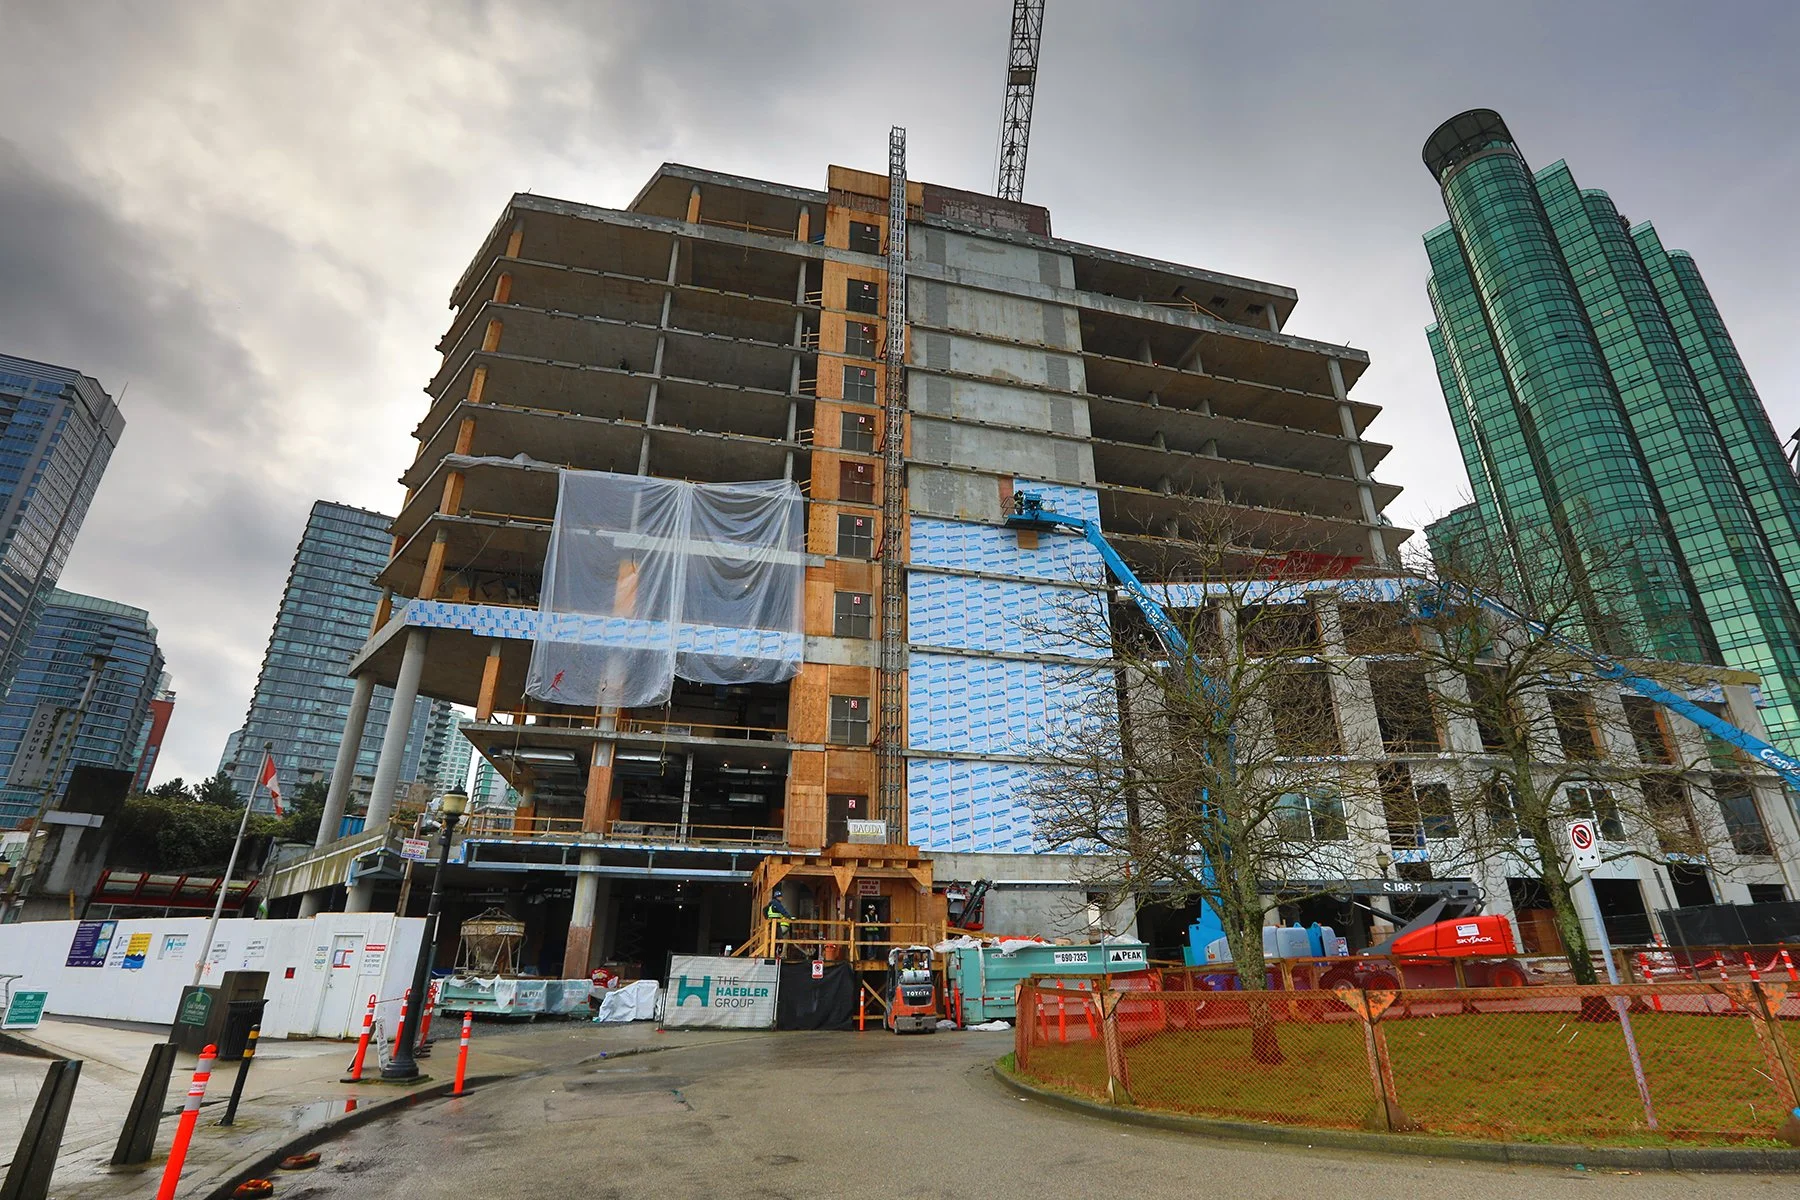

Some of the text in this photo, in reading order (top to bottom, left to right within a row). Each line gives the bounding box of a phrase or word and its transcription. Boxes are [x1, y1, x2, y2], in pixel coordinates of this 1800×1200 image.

[17, 713, 48, 784] COMMUNITY
[1456, 935, 1493, 944] SKYJACK
[1122, 951, 1142, 960] PEAK
[717, 976, 739, 986] THE
[716, 987, 768, 997] HAEBLER
[714, 998, 755, 1008] GROUP
